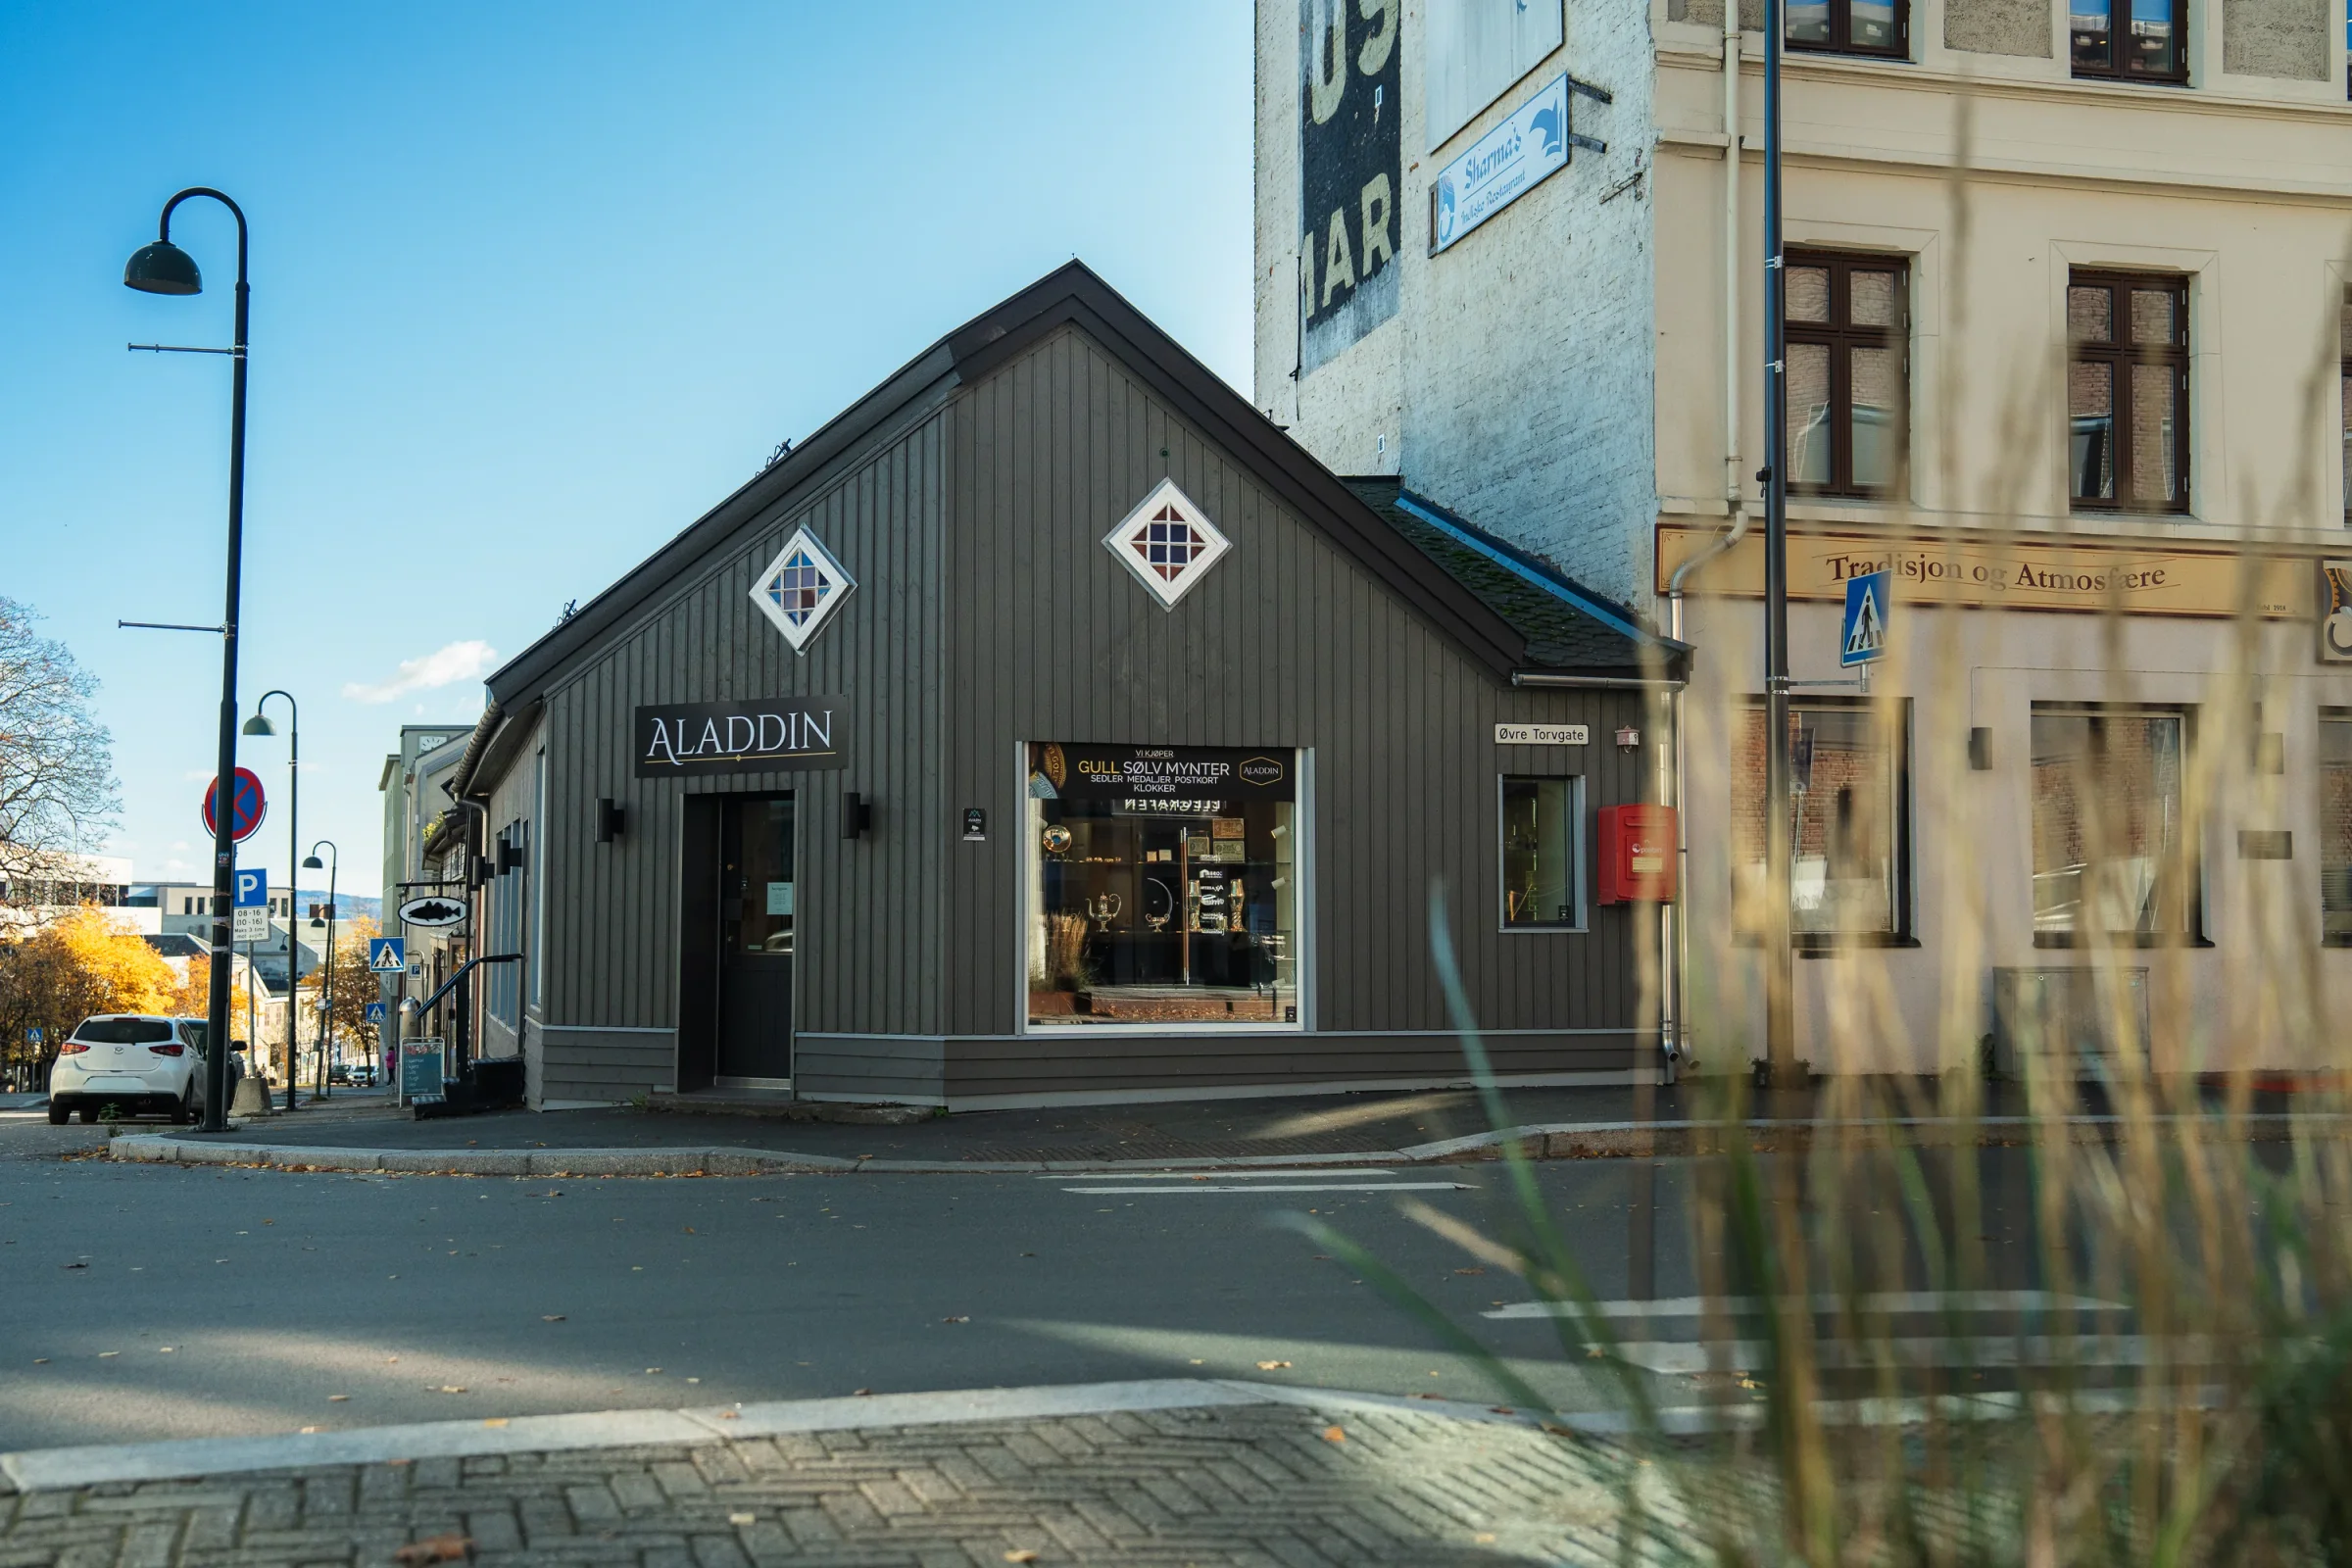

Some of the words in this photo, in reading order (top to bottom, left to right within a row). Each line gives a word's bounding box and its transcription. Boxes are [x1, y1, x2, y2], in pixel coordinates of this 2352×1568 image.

[1464, 126, 1522, 190] Sharma's
[1487, 168, 1526, 207] Restaurant
[1826, 553, 1963, 584] Tradisjon
[1973, 565, 2007, 592] og
[2015, 564, 2166, 592] Atmosfære
[1499, 728, 1527, 739] Øvre
[1533, 728, 1584, 743] Torvgate
[1078, 760, 1120, 774] GULL
[1123, 760, 1163, 774] SØLV
[1166, 761, 1230, 776] MYNTER
[1091, 774, 1123, 783] SEDLER
[1127, 775, 1171, 784] MEDALJER
[1175, 775, 1218, 784] POSTKORT
[238, 874, 258, 903] P
